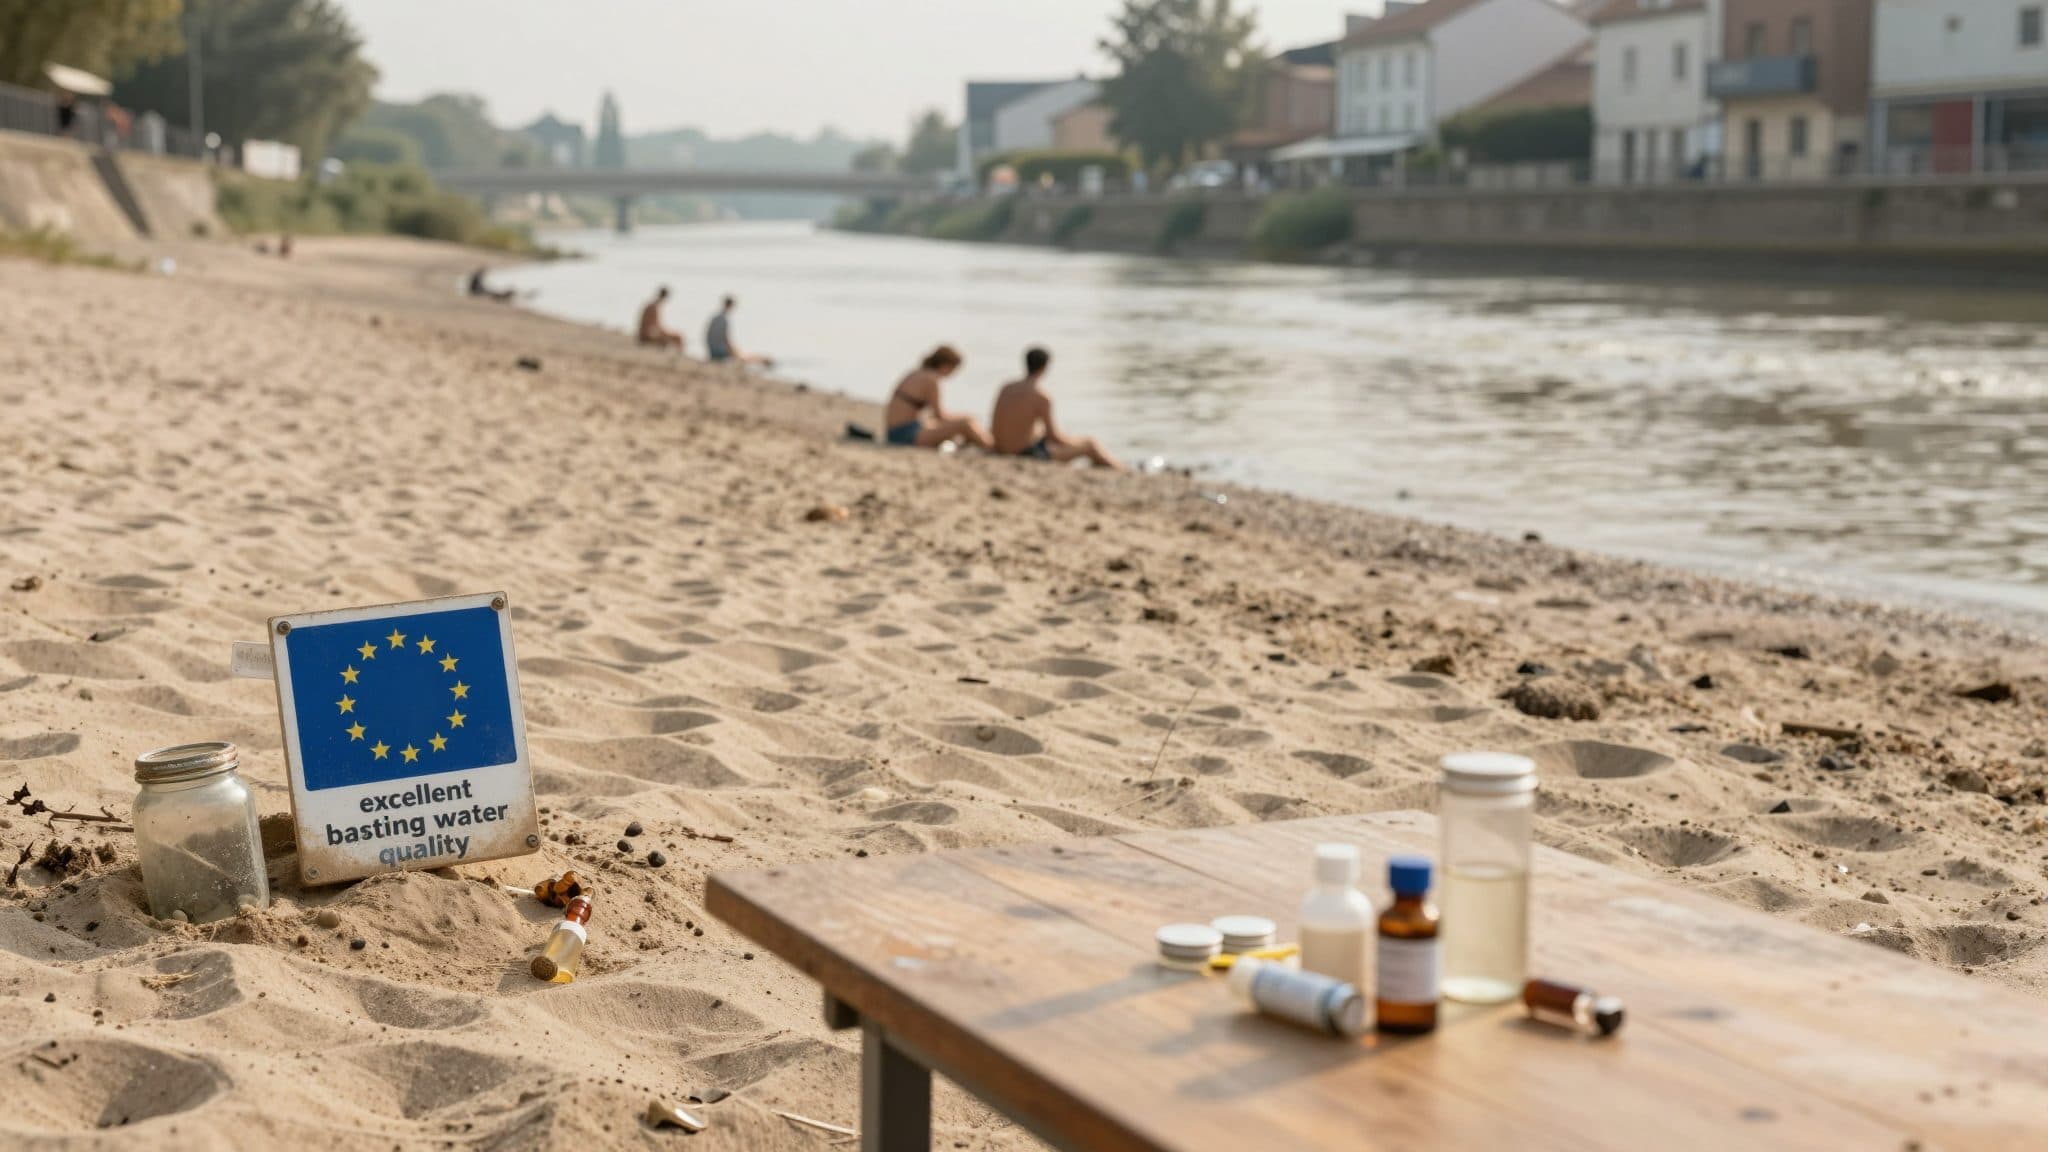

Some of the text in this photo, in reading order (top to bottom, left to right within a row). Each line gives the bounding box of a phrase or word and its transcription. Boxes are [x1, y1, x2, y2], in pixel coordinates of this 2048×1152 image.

[360, 779, 472, 813] excellent
[326, 803, 508, 846] basting water
[379, 834, 470, 866] quality
